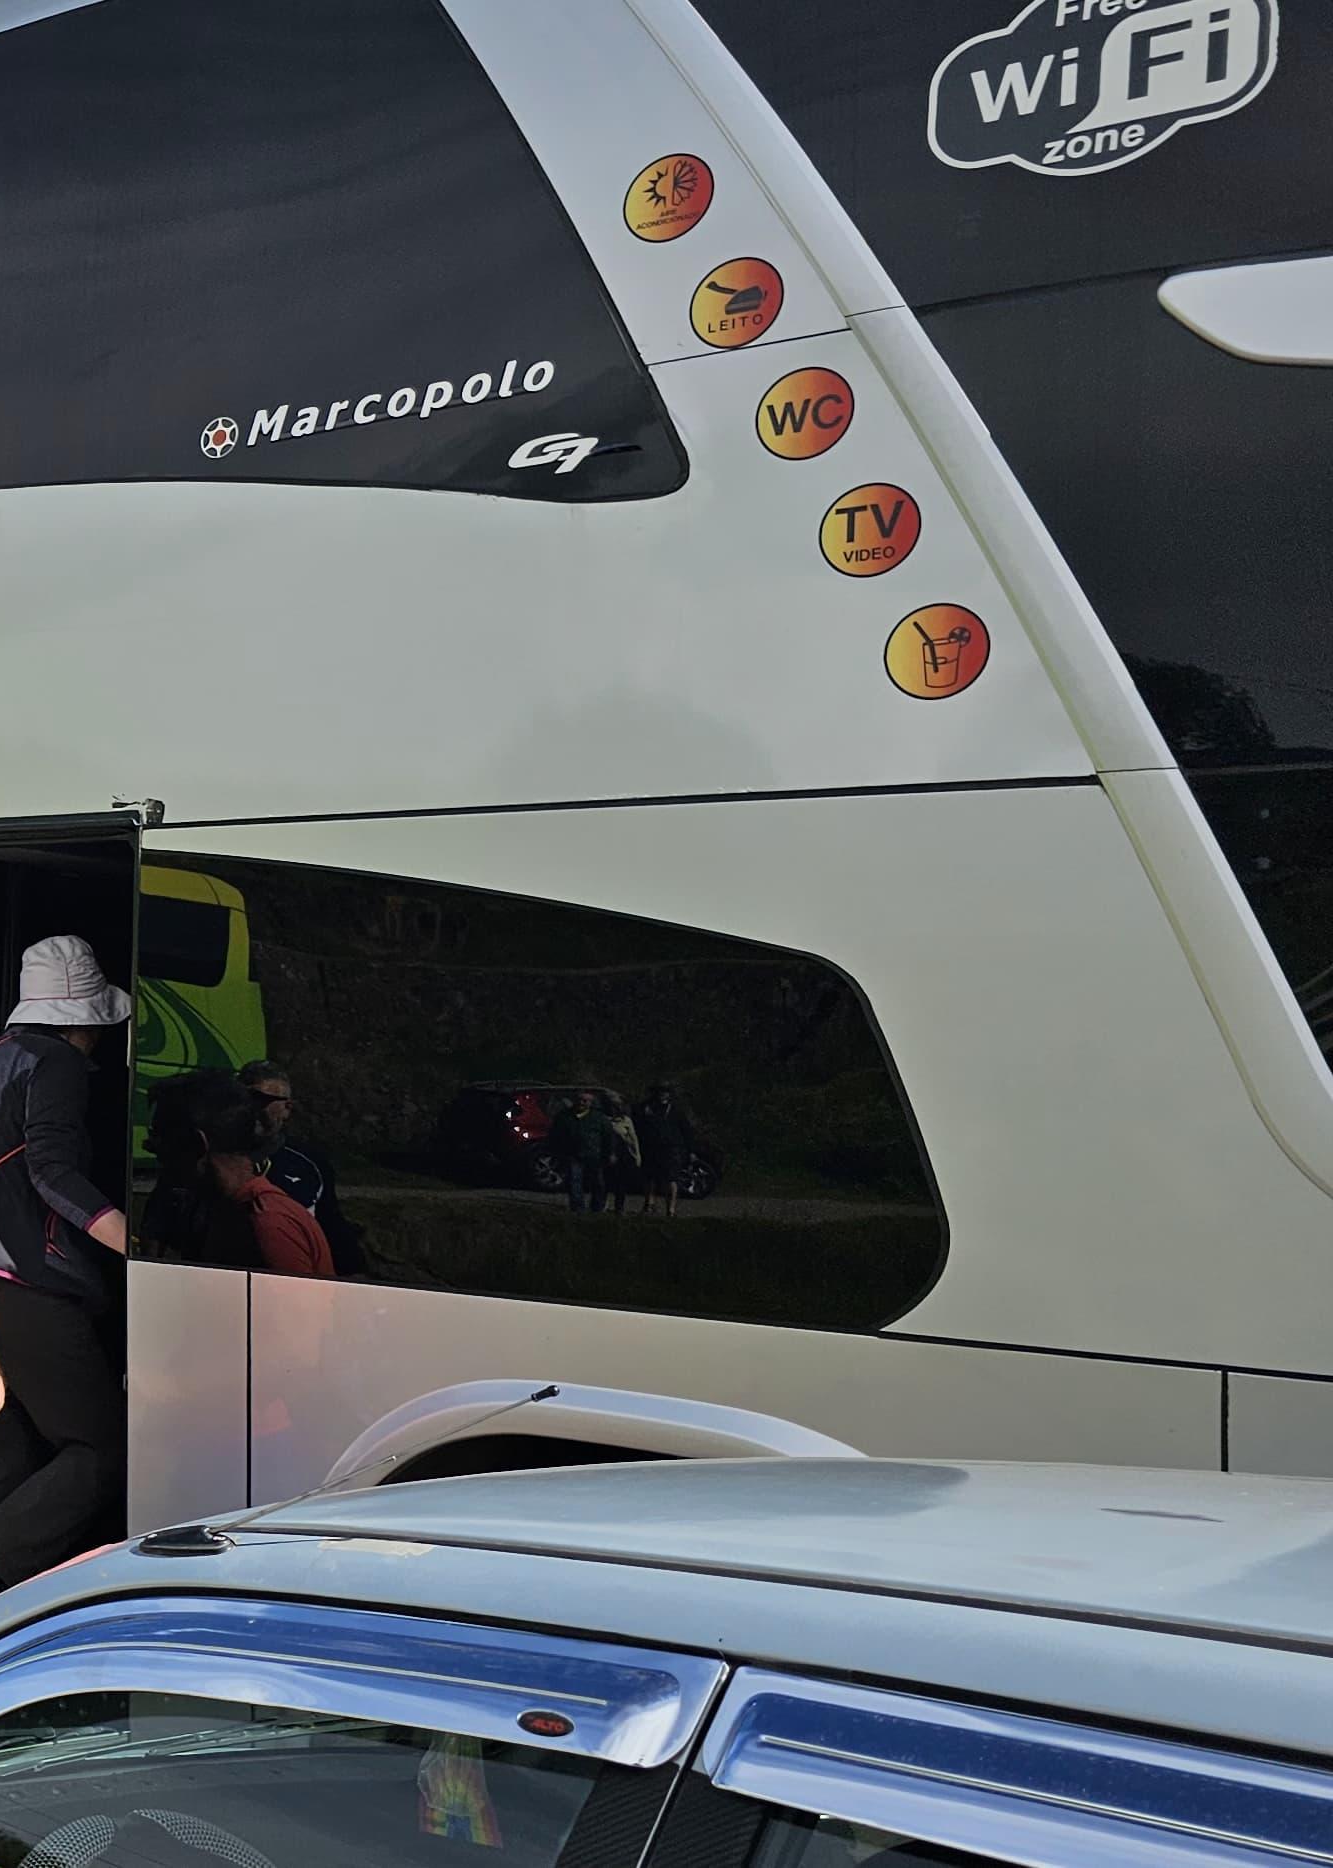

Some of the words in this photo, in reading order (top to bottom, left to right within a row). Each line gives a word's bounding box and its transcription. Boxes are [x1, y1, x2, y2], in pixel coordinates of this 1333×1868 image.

[1042, 124, 1145, 164] zone
[707, 313, 764, 334] LEITO
[247, 359, 555, 447] Marcopolo
[766, 393, 844, 436] WC
[507, 432, 599, 475] G7
[834, 499, 905, 544] TV
[843, 545, 896, 564] VIDEO
